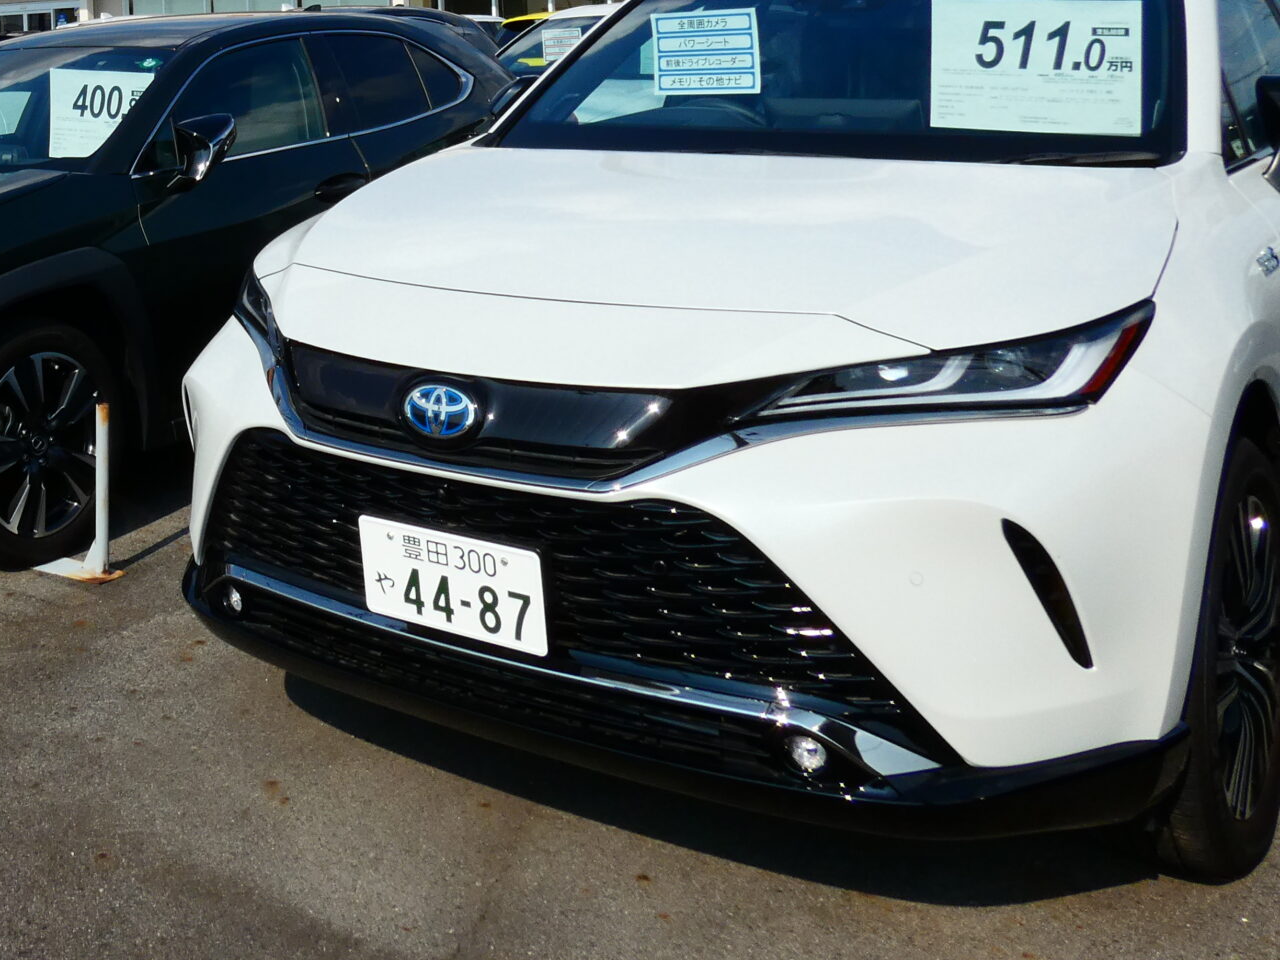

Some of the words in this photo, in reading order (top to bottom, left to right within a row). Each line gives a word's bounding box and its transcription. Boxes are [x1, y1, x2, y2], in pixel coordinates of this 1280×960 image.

[678, 37, 731, 49] パワーシート
[975, 20, 1107, 72] 511.0
[402, 534, 449, 567] 豊田
[453, 545, 497, 578] 300
[374, 570, 395, 595] や
[403, 567, 532, 642] 44-87
